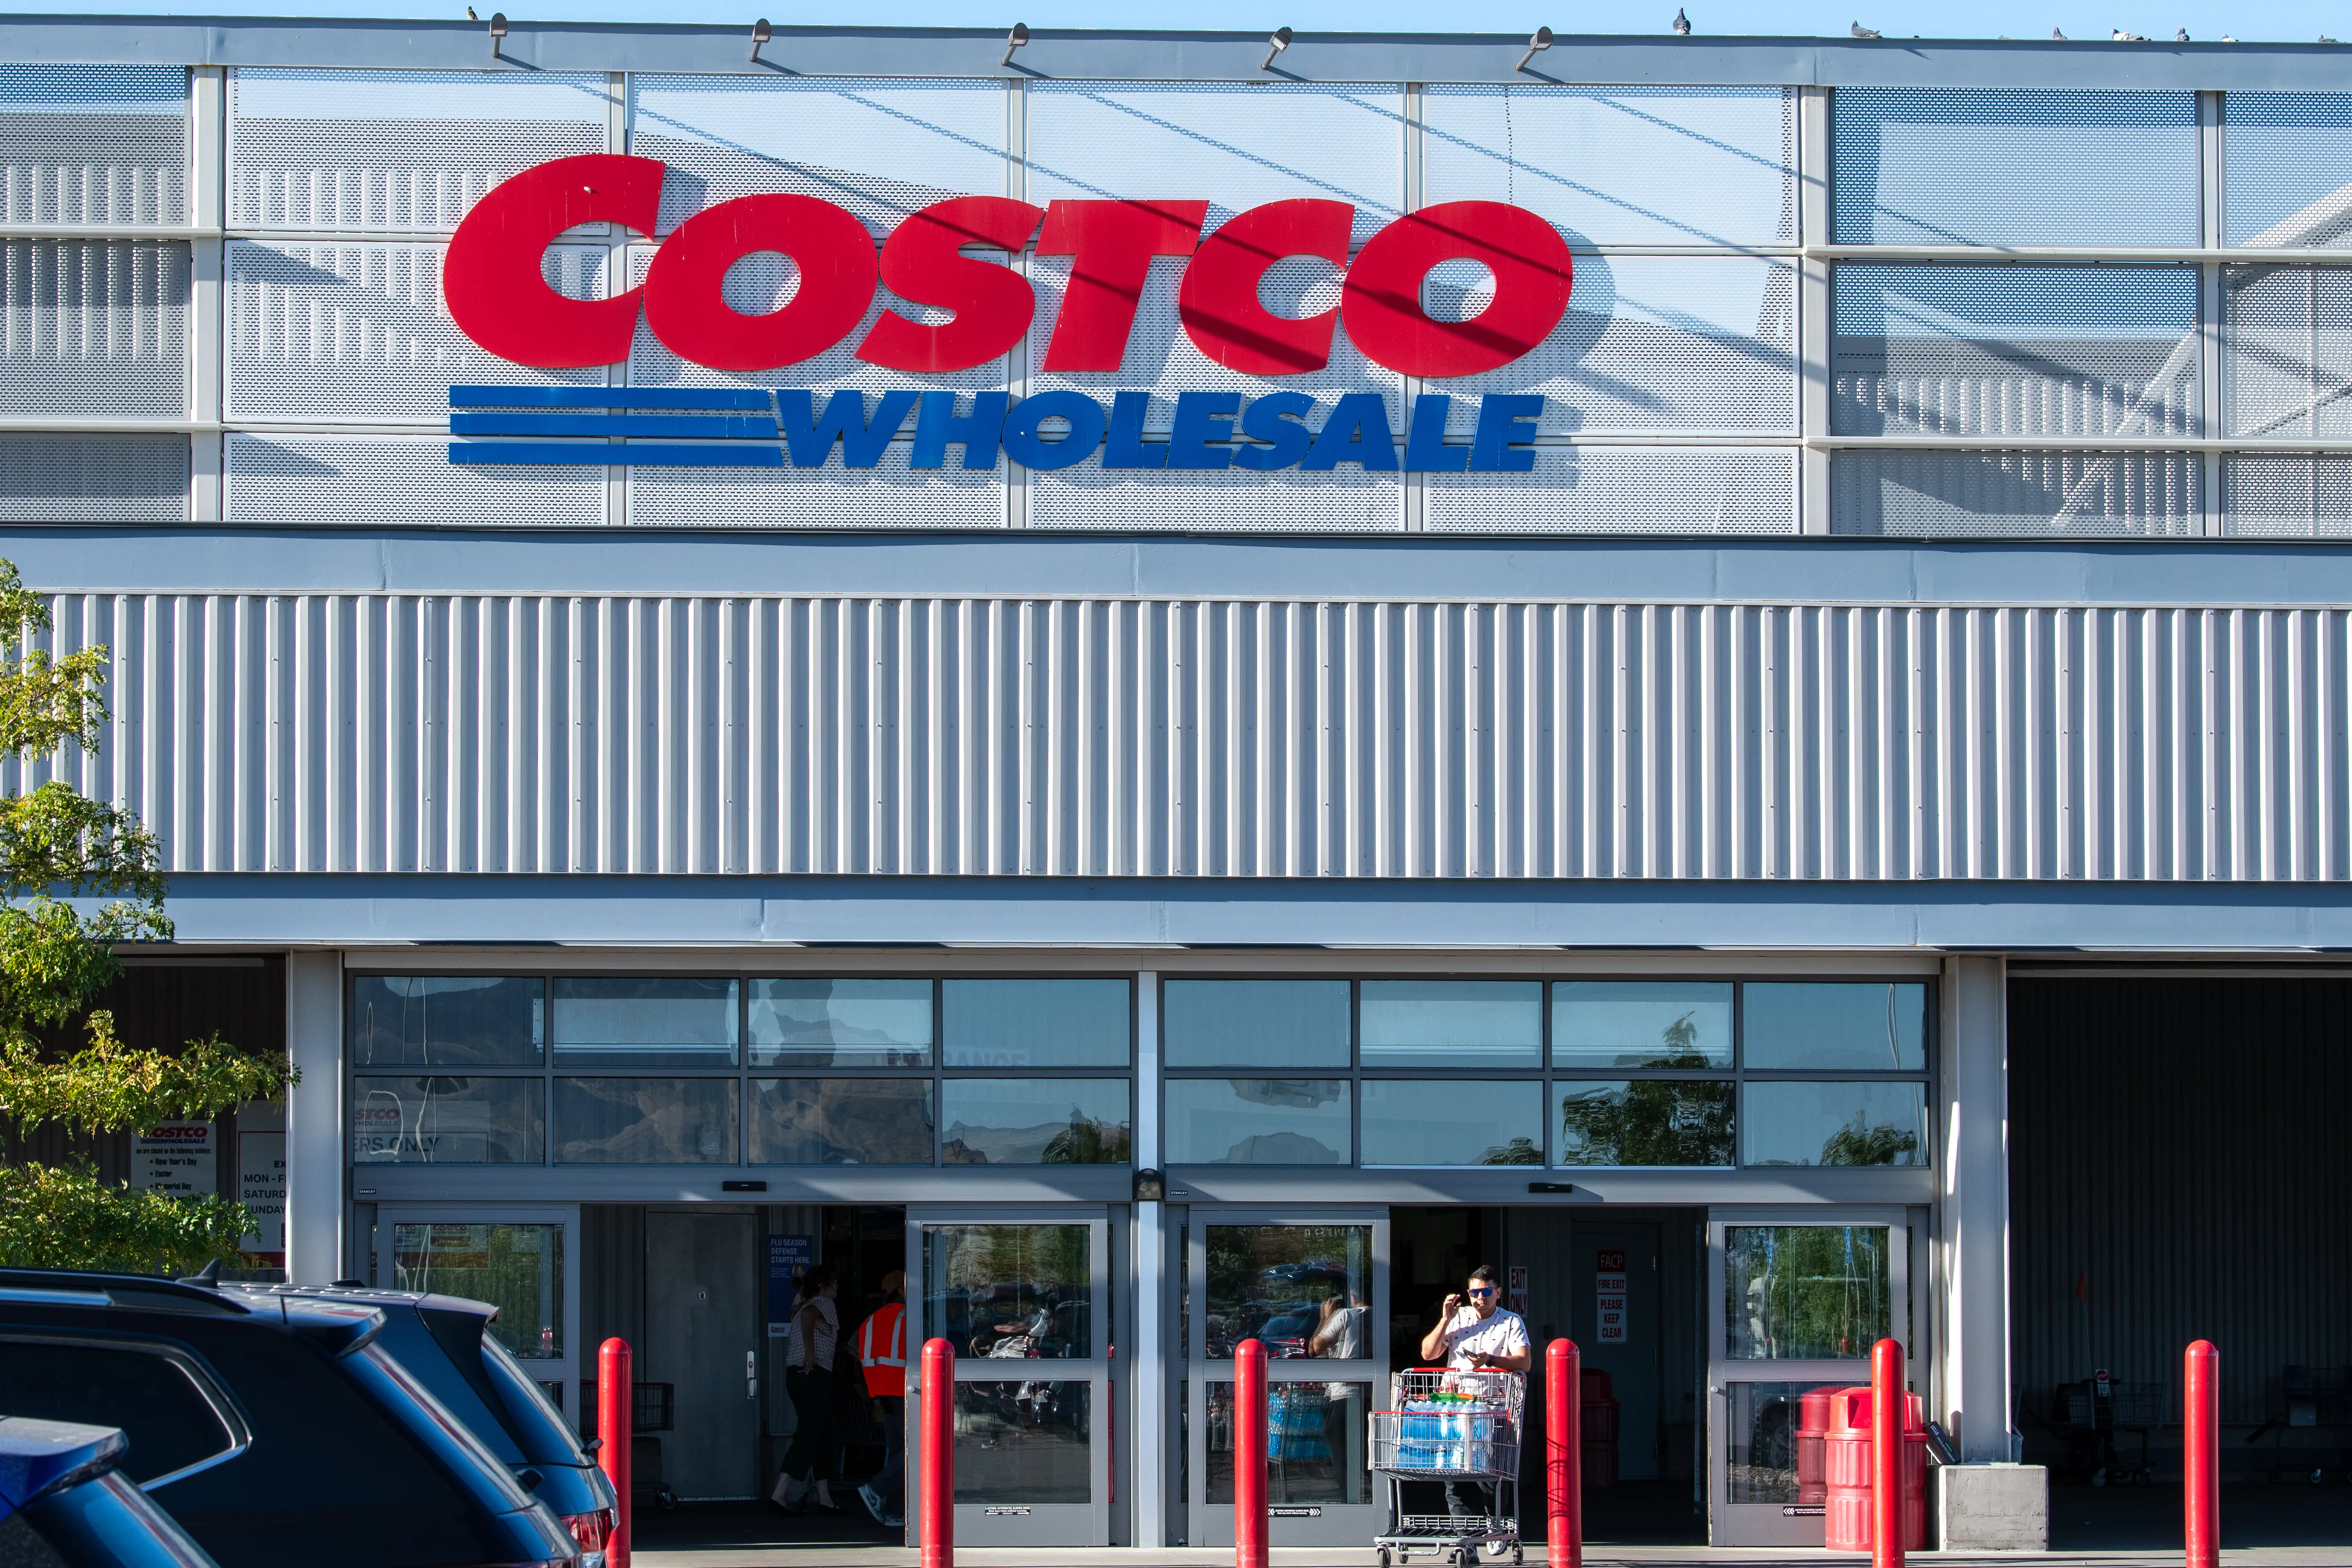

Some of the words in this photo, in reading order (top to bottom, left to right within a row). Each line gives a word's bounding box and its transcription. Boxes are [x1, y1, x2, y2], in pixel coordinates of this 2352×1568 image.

[443, 153, 1573, 378] COSTCO
[776, 390, 1545, 472] WHOLESALE
[144, 1127, 207, 1138] OSTCO
[389, 1137, 439, 1152] ONLY
[244, 1174, 269, 1183] MON
[278, 1174, 286, 1183] F
[244, 1190, 286, 1198] SATURD
[251, 1206, 286, 1214] UNDAY
[1601, 1255, 1623, 1268] FACP
[1511, 1268, 1525, 1289] EXIT
[1598, 1279, 1611, 1288] FIRE
[1612, 1279, 1625, 1289] EXIT
[1510, 1293, 1527, 1315] ONLY
[1601, 1299, 1623, 1309] PLEASE
[1604, 1313, 1620, 1323] KEEP
[1602, 1328, 1622, 1338] CLEAR
[1930, 1425, 1939, 1435] CELLO
